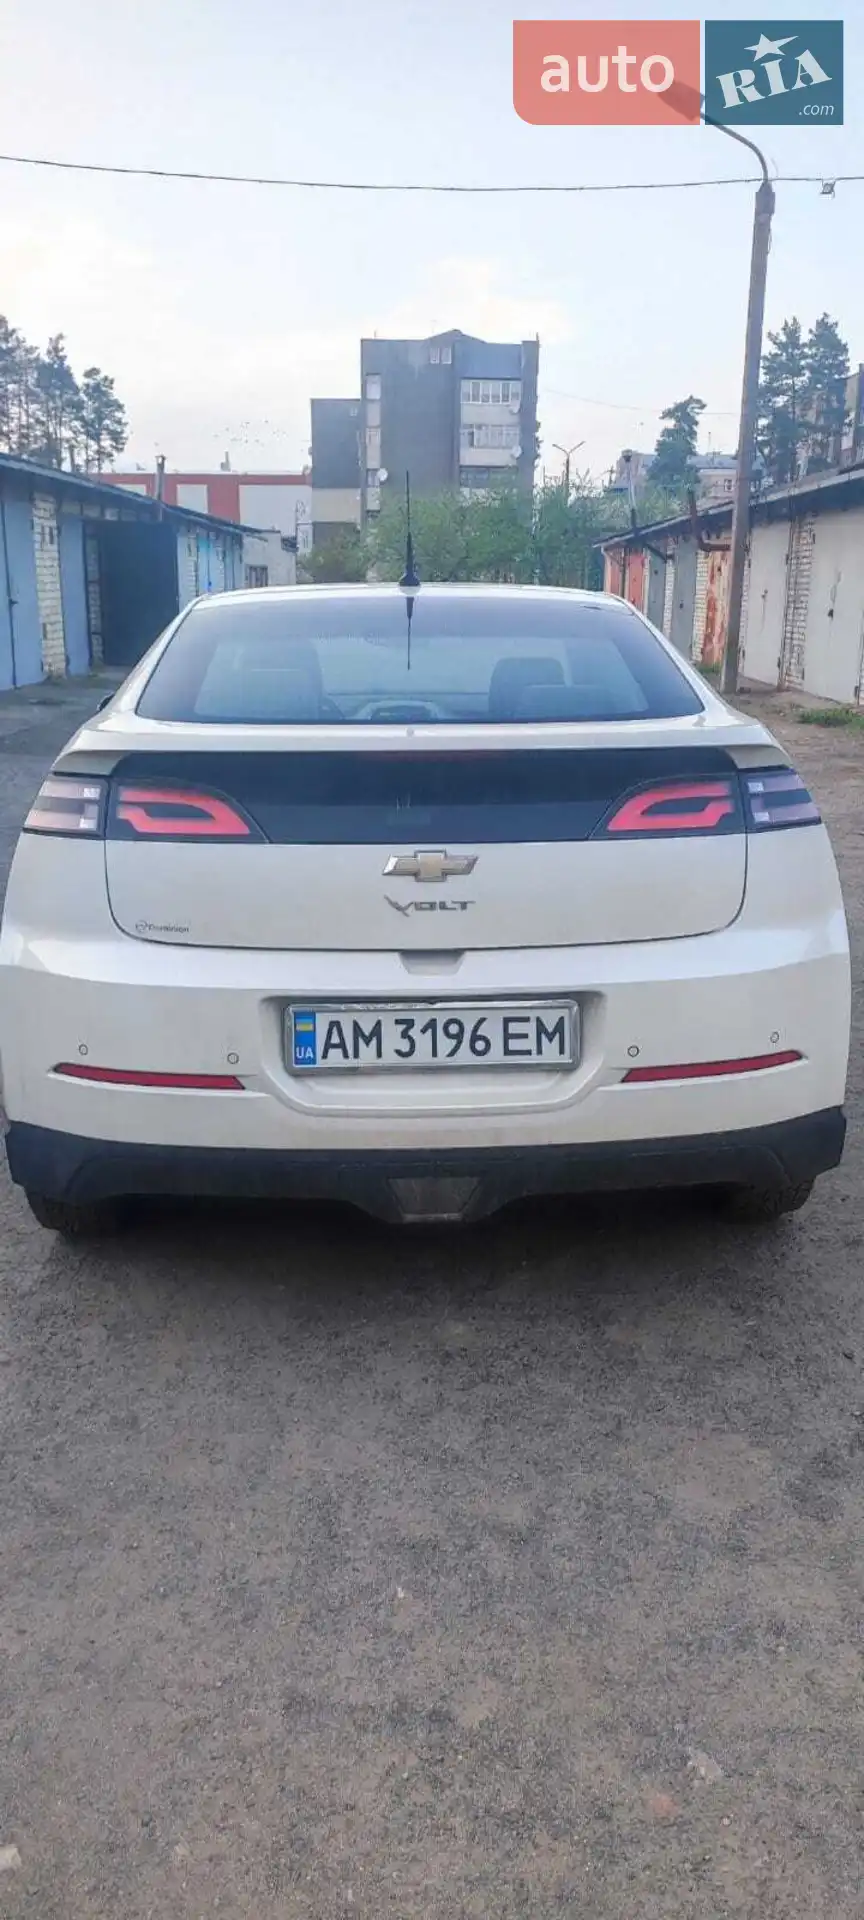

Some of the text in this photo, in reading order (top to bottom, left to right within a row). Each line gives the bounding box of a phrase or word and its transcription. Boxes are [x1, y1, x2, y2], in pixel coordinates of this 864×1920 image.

[383, 894, 476, 917] VOLT
[321, 1015, 565, 1060] AM 3196 EM
[295, 1046, 314, 1060] UA
